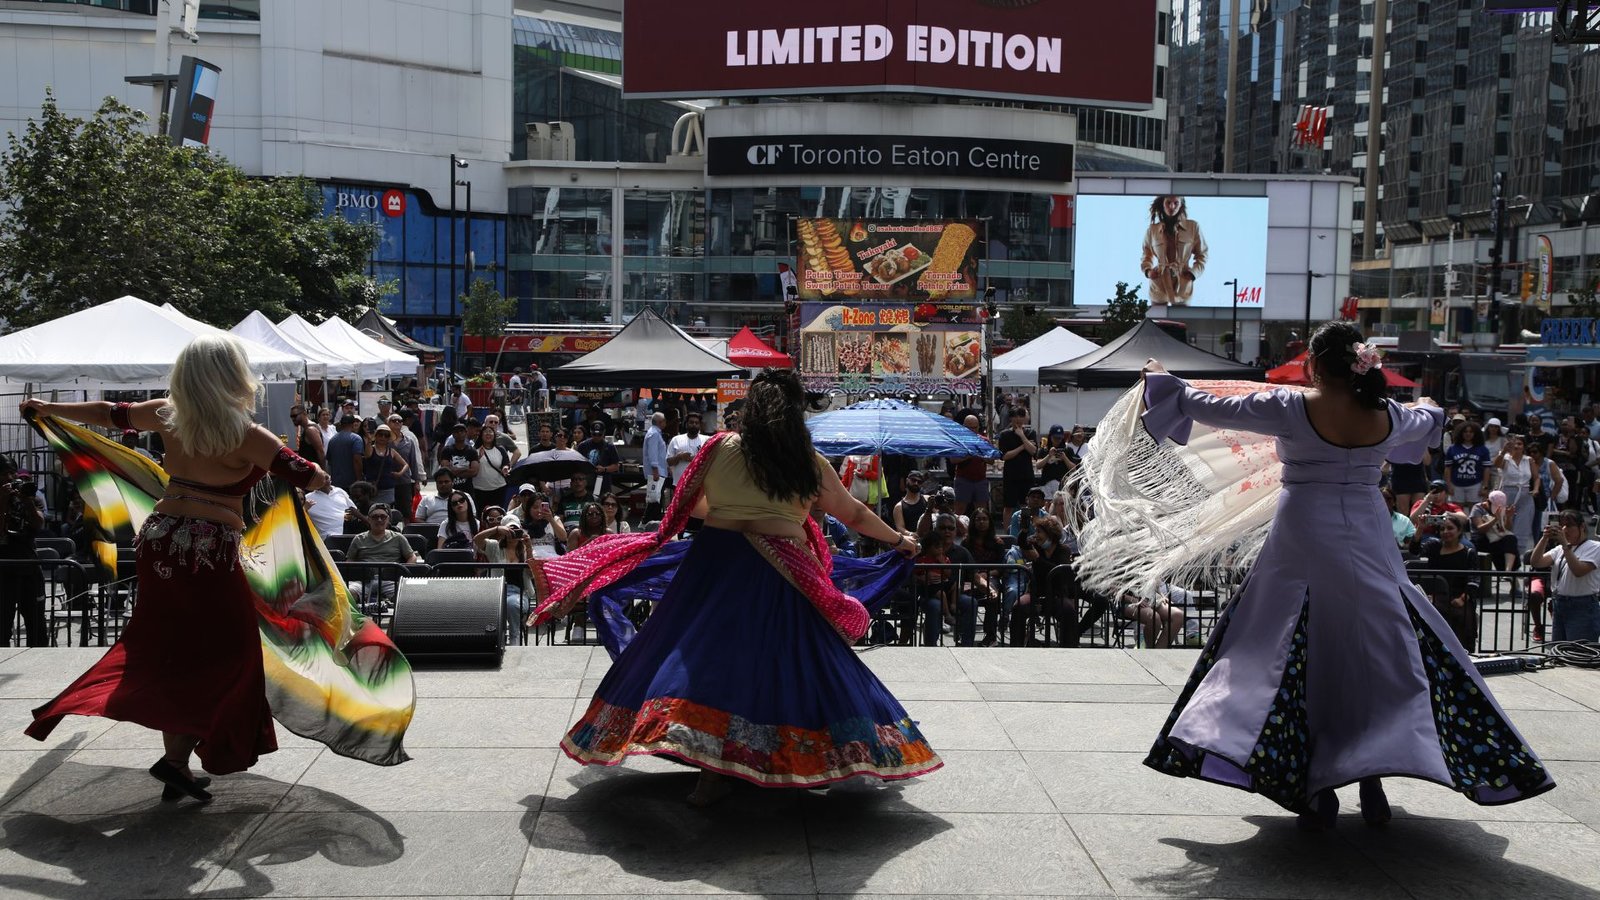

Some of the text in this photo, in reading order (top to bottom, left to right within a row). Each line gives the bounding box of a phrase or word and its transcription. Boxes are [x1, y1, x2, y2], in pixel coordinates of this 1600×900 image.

[726, 24, 1063, 75] LIMITED EDITION
[746, 144, 1041, 171] CF Toronto Eaton Centre
[337, 192, 378, 210] BMO
[857, 238, 897, 261] Takoyaki
[805, 270, 863, 280] Potato Tower
[925, 270, 962, 280] Tornado
[805, 281, 890, 291] Sweet Potato Tower
[917, 280, 969, 291] Potato Fries
[1540, 317, 1592, 344] GREEK
